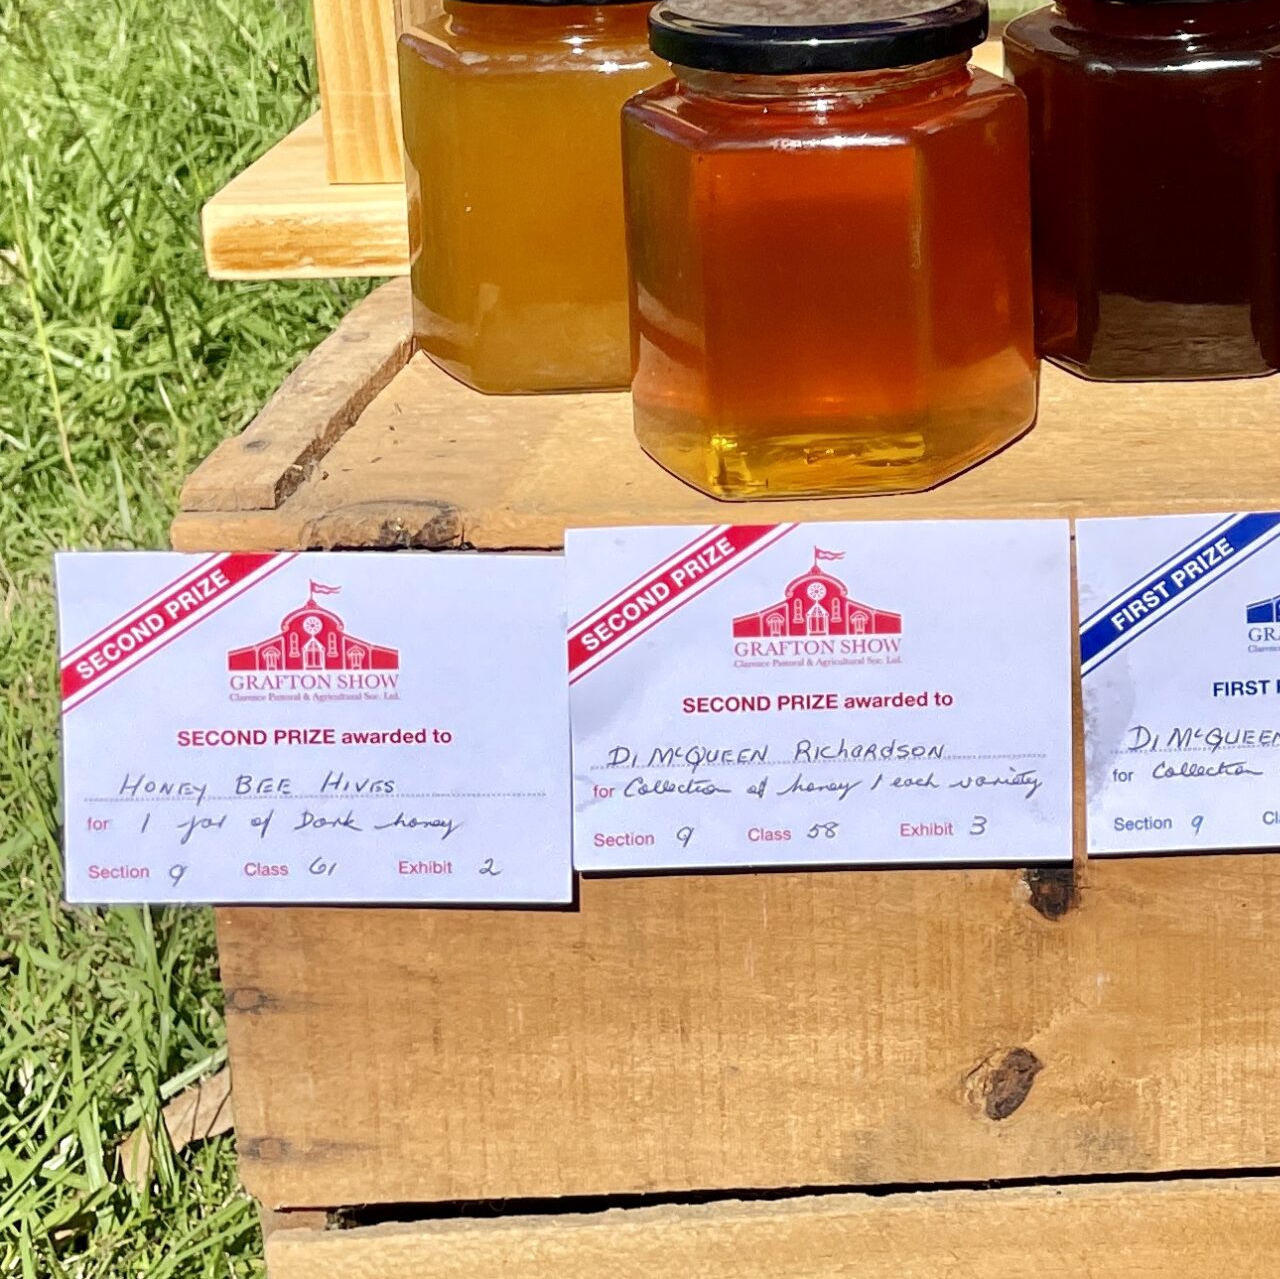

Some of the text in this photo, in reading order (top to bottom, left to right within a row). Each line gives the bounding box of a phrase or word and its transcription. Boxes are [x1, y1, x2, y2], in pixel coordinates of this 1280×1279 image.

[581, 537, 735, 652] SECOND PRIZE
[1111, 536, 1235, 631] FIRST PRIZE
[76, 568, 231, 681] SECOND PRIZE
[734, 638, 902, 657] GRAFTON SHOW
[230, 674, 399, 690] GRAFTON SHOW
[1212, 679, 1271, 697] FIRST
[682, 692, 953, 714] SECOND PRIZE awarded to
[177, 728, 452, 747] SECOND PRIZE awarded to
[593, 785, 615, 798] for
[747, 776, 768, 798] of
[776, 773, 862, 800] honey
[890, 772, 939, 788] each
[950, 767, 1042, 799] variety
[1113, 770, 1134, 782] for
[119, 771, 395, 806] HONEY BEE HIVES
[86, 816, 110, 833] for
[178, 813, 228, 843] jar
[250, 809, 275, 838] of
[293, 810, 363, 832] Dark
[374, 811, 462, 840] honey
[594, 816, 987, 848] Section 9 Class 58 Exhibit 3
[1114, 816, 1172, 831] Section
[1191, 815, 1204, 835] 9
[87, 864, 150, 881] Section
[244, 861, 289, 877] Class
[398, 859, 453, 875] Exhibit
[478, 857, 501, 876] 2
